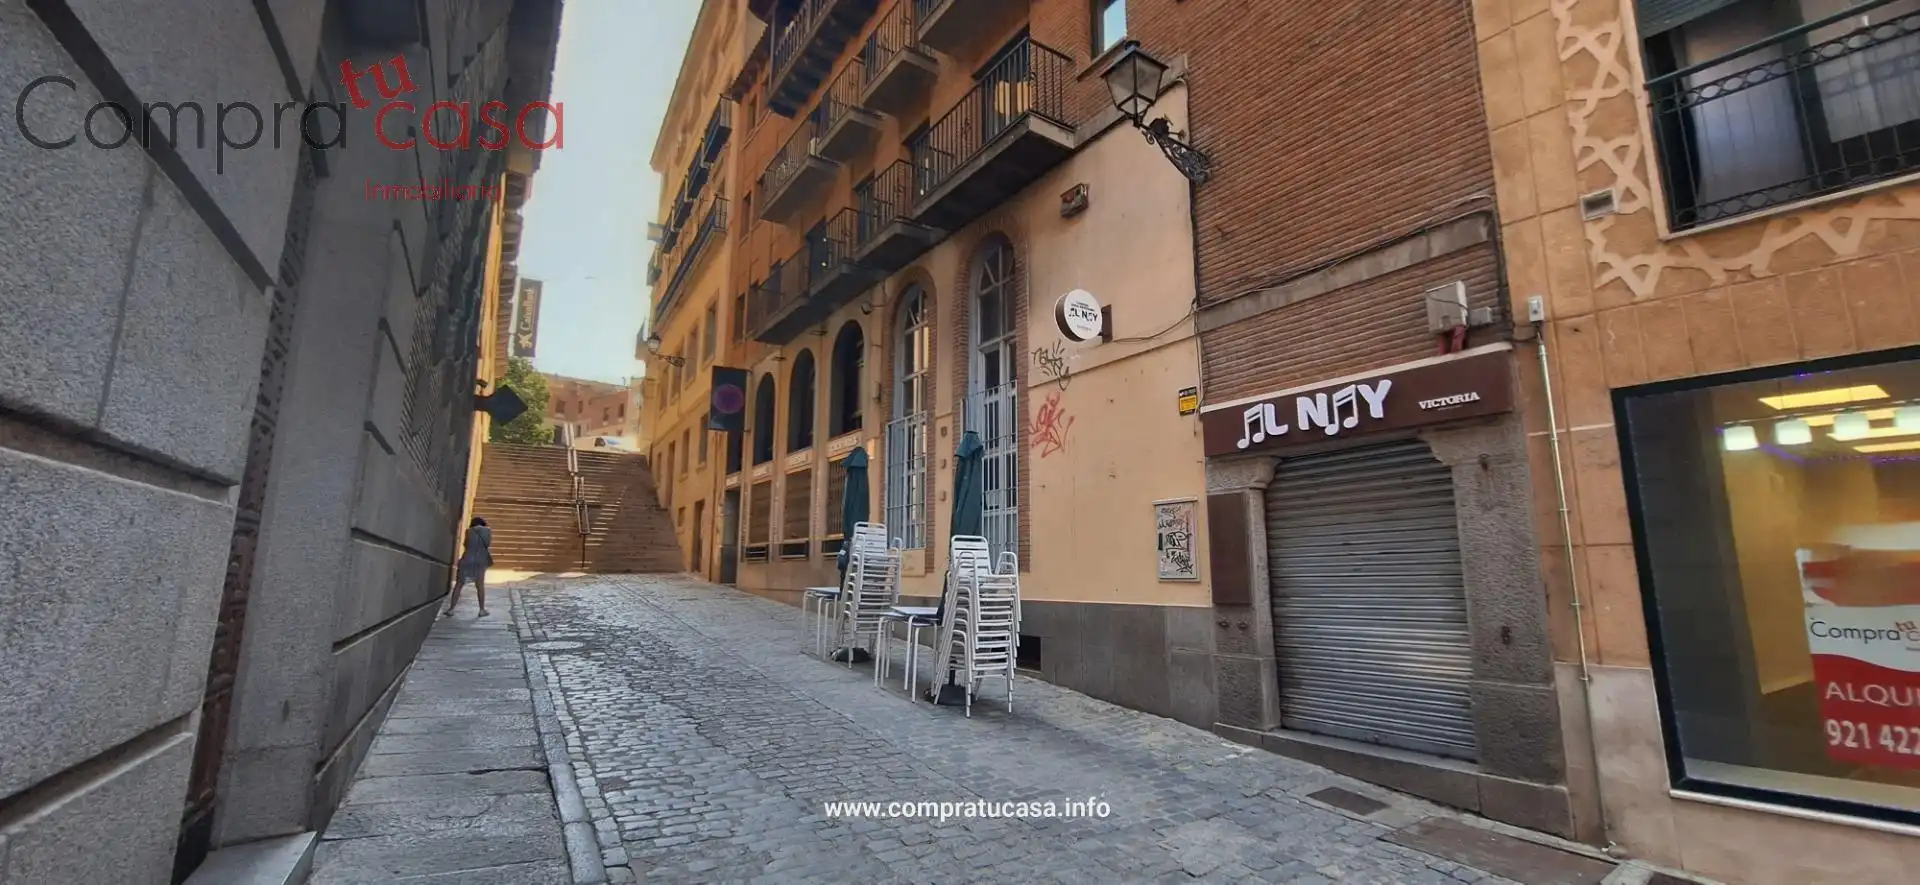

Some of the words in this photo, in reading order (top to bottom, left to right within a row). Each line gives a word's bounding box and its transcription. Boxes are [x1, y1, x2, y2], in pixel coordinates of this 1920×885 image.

[1418, 391, 1480, 410] VICTORIA
[1810, 620, 1900, 645] Compra
[1826, 718, 1872, 750] 921
